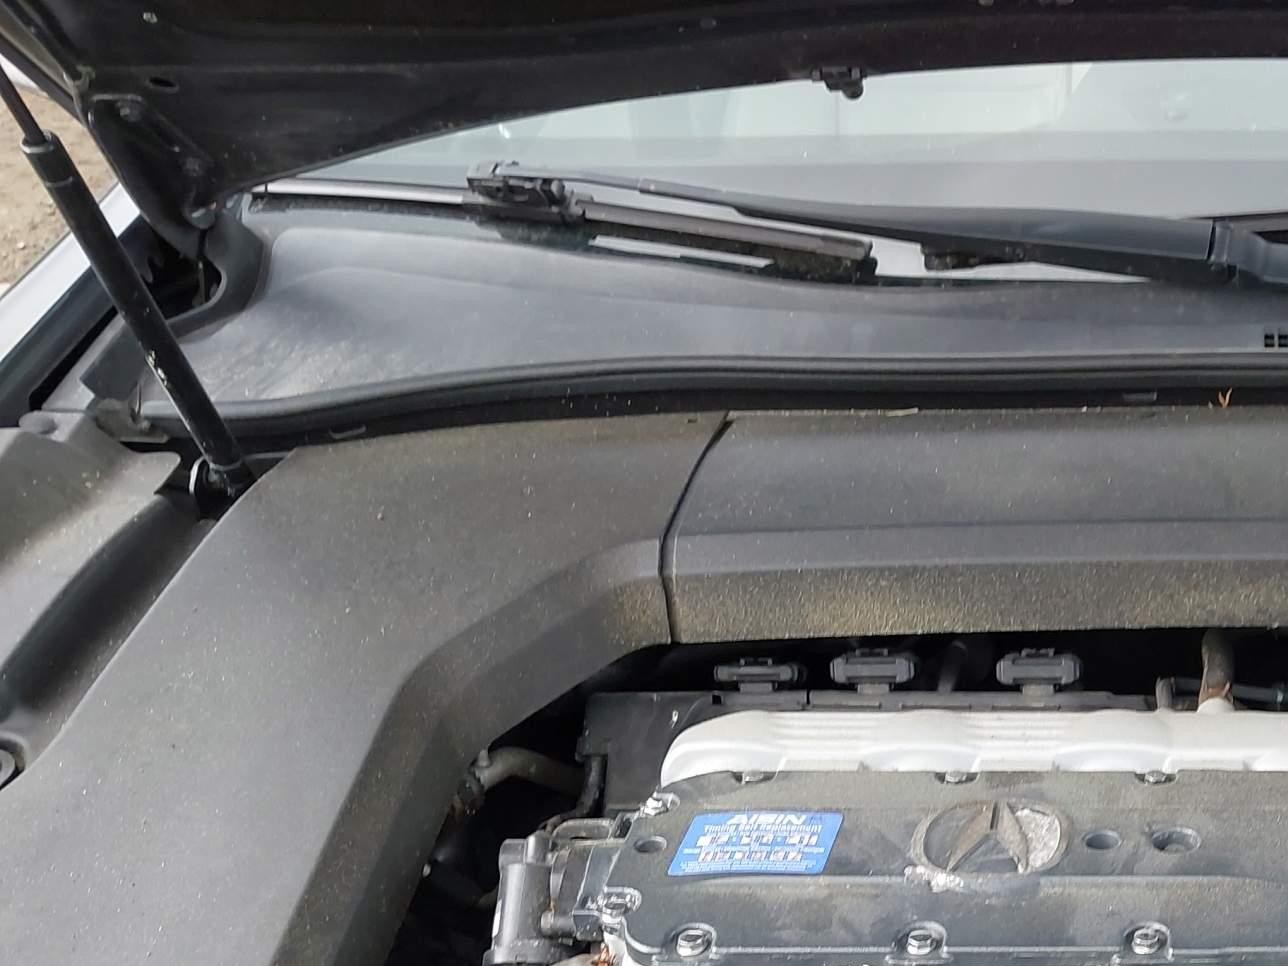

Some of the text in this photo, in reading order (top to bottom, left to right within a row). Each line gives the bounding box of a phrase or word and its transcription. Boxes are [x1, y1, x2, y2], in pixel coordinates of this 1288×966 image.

[726, 813, 807, 825] AISIN
[704, 825, 736, 834] Timing
[759, 825, 822, 834] Replacement
